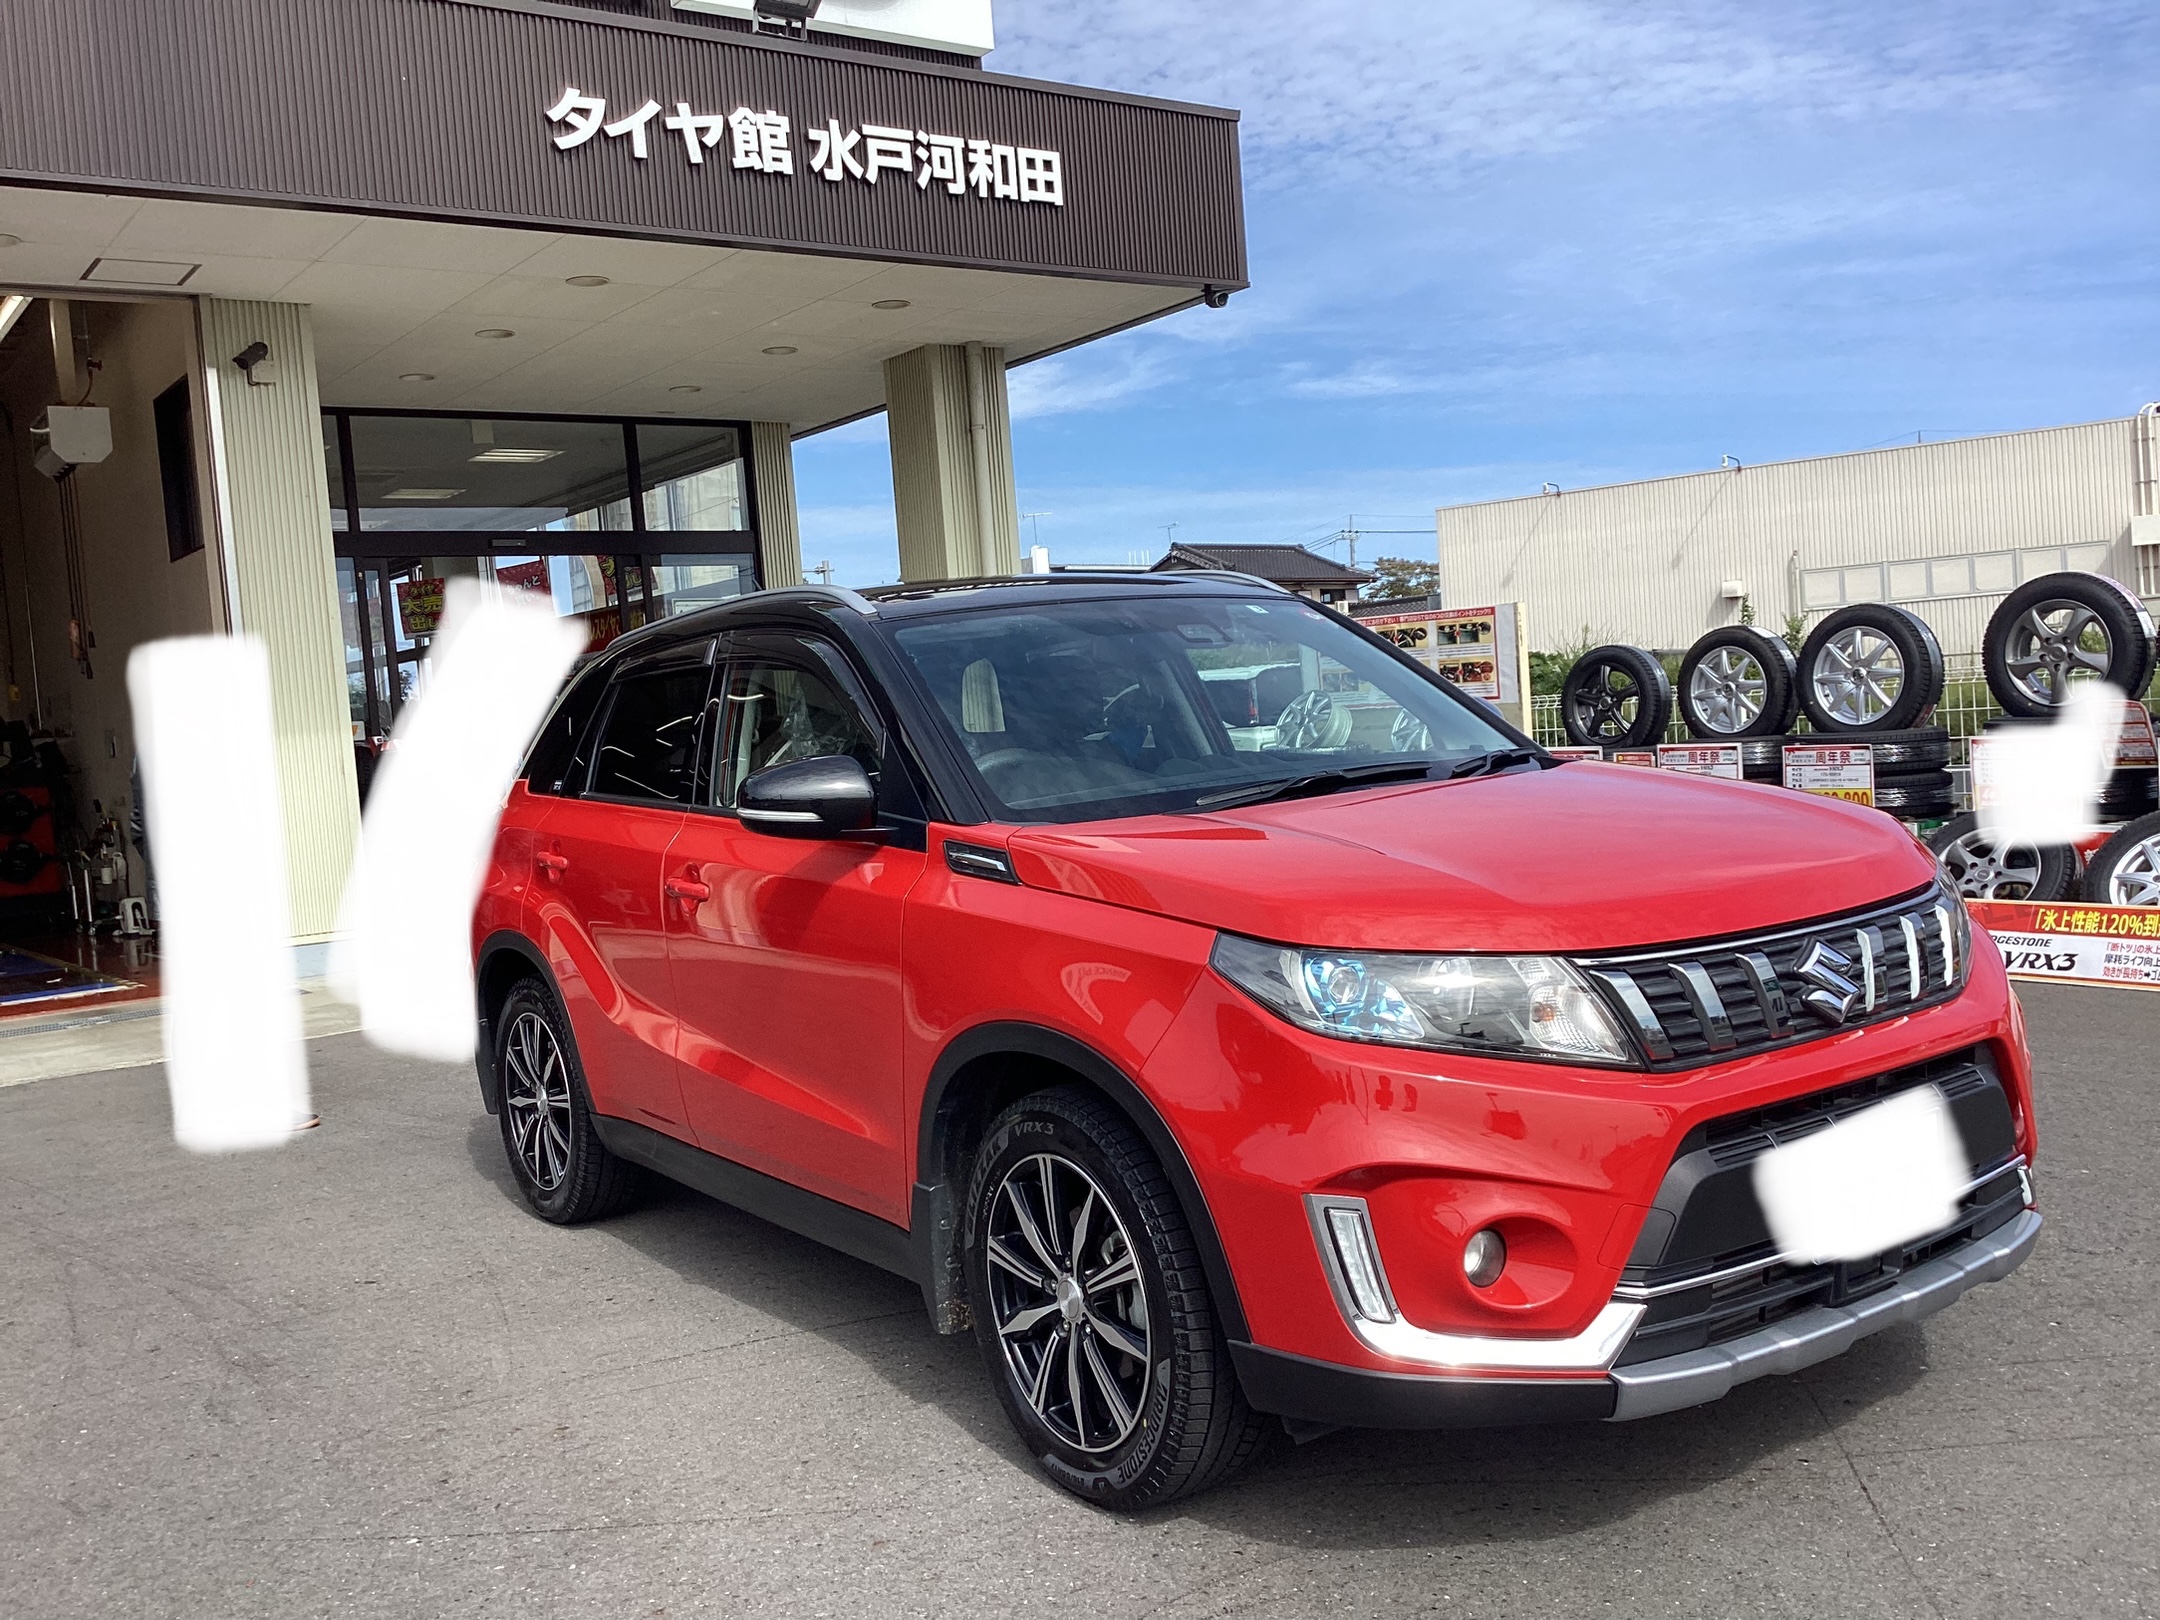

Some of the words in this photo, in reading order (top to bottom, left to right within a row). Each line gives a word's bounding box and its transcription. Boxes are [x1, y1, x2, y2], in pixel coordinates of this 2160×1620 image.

[546, 86, 793, 175] タイヤ館
[808, 119, 1063, 206] 水戸河和田
[2035, 908, 2160, 937] 「氷上性能120%到
[2004, 950, 2079, 971] VRX3
[1014, 1121, 1055, 1137] VRX3
[1117, 1381, 1168, 1484] BRIDGESTONE
